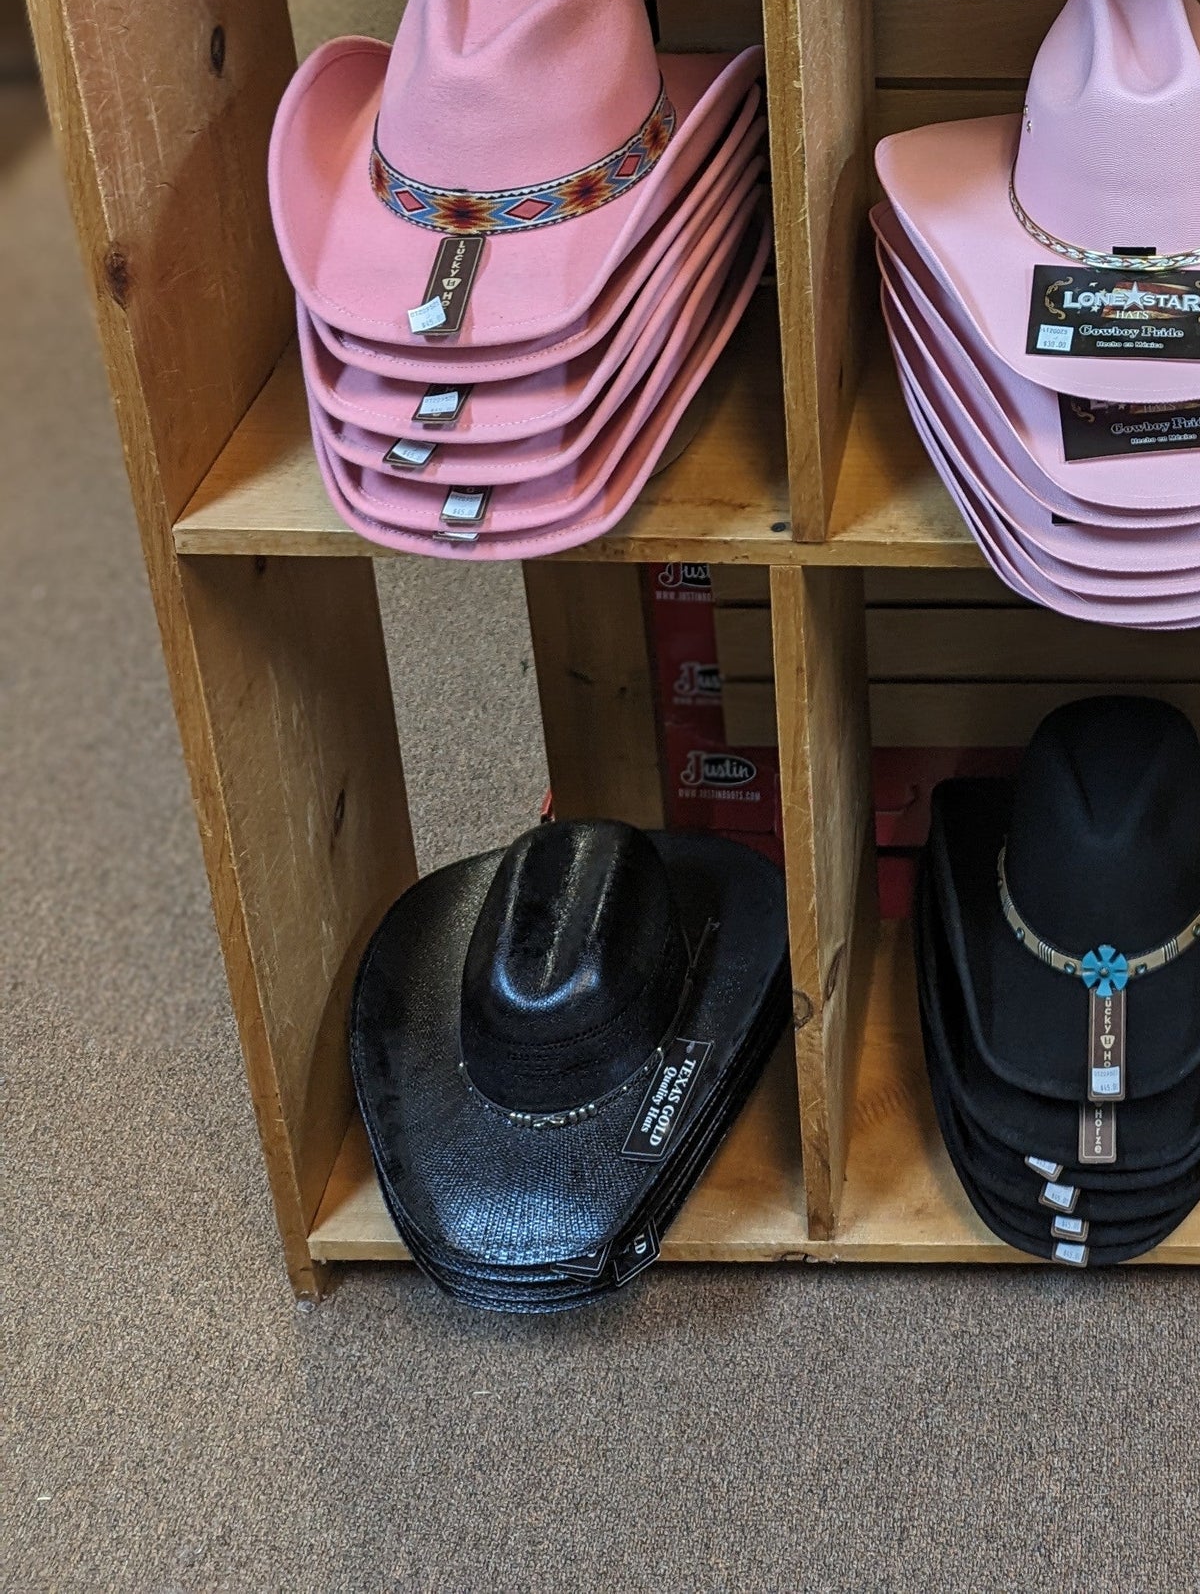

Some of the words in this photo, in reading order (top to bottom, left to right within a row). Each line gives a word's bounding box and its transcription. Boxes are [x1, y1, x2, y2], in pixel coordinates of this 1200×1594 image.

[450, 240, 466, 277] Lucky
[1063, 291, 1126, 309] LONE
[1115, 310, 1149, 319] HATS
[1079, 325, 1140, 339] Cowboy
[1141, 326, 1184, 338] Pride
[1111, 421, 1170, 435] Cowboy
[680, 750, 750, 785] Justin
[652, 1066, 678, 1105] Quality
[668, 1058, 697, 1104] TEXAS
[640, 1106, 660, 1133] Hats
[649, 1105, 675, 1146] GOLD
[1094, 1109, 1103, 1154] Horze
